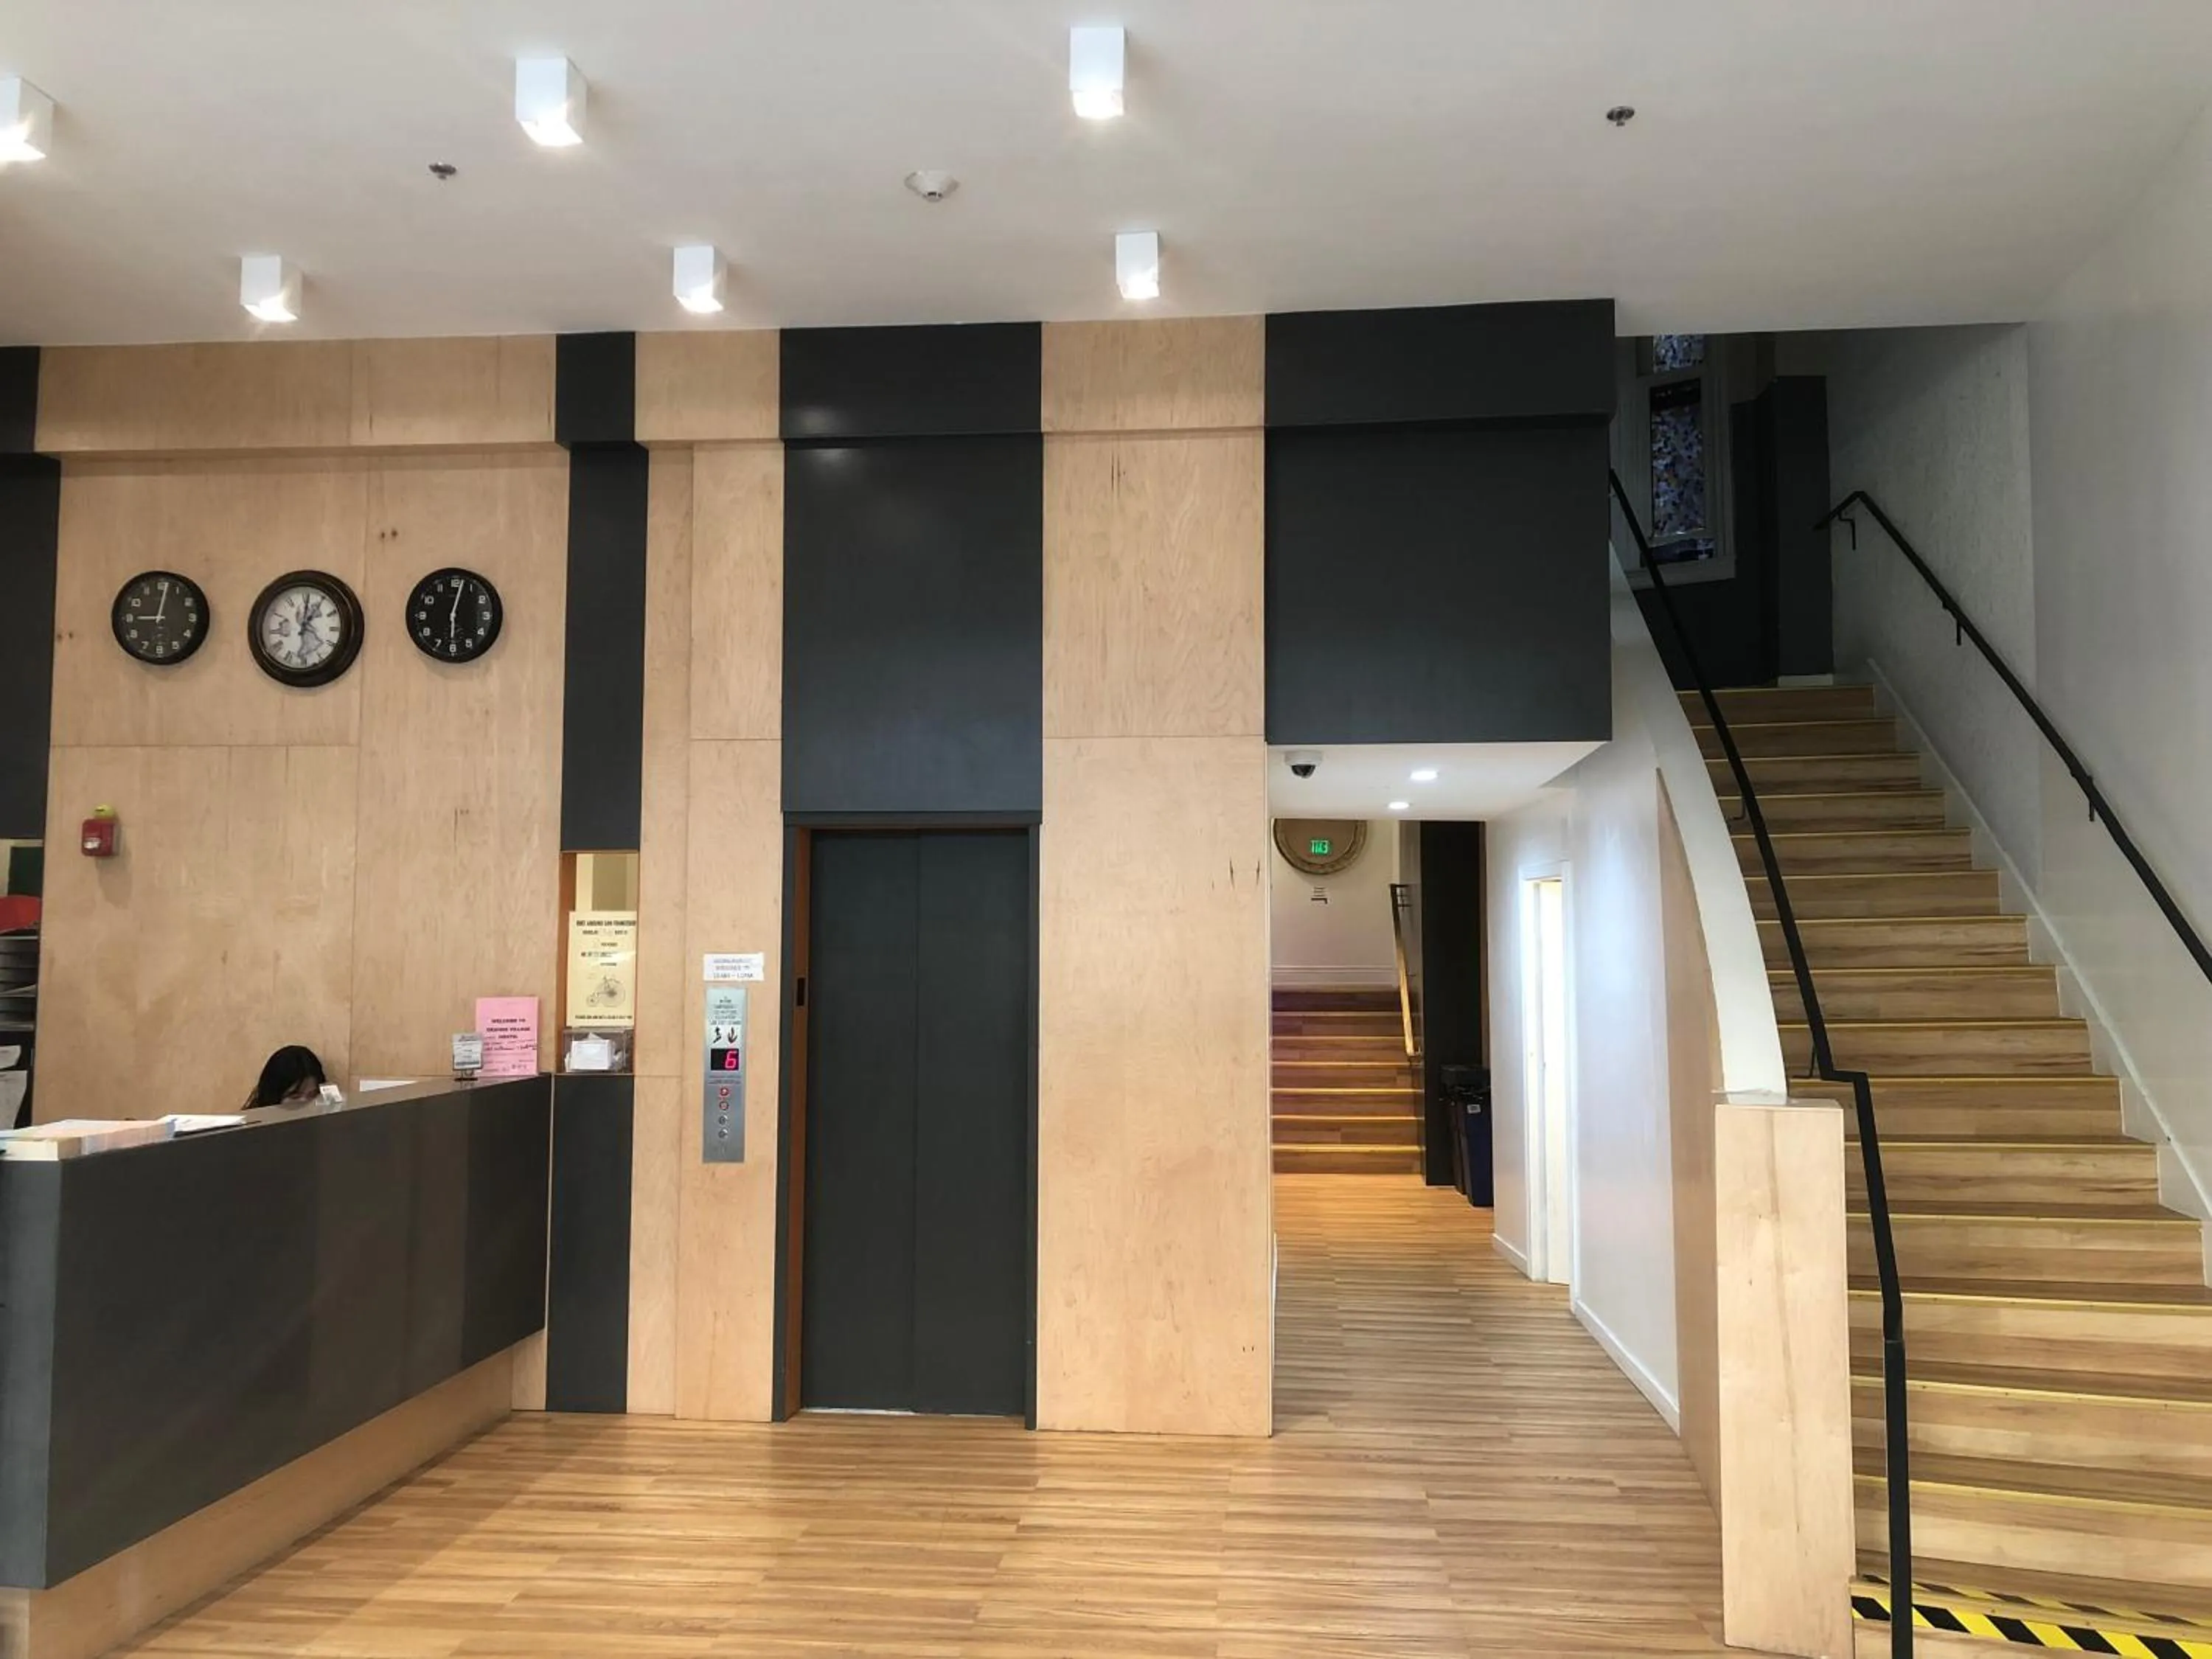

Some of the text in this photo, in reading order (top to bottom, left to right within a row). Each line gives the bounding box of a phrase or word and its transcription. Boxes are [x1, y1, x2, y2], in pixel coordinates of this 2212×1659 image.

[188, 613, 197, 622] 3
[183, 630, 191, 639] 4
[477, 627, 484, 636] 4
[141, 641, 149, 650] 7
[434, 639, 442, 647] 7
[725, 1051, 737, 1069] 6
